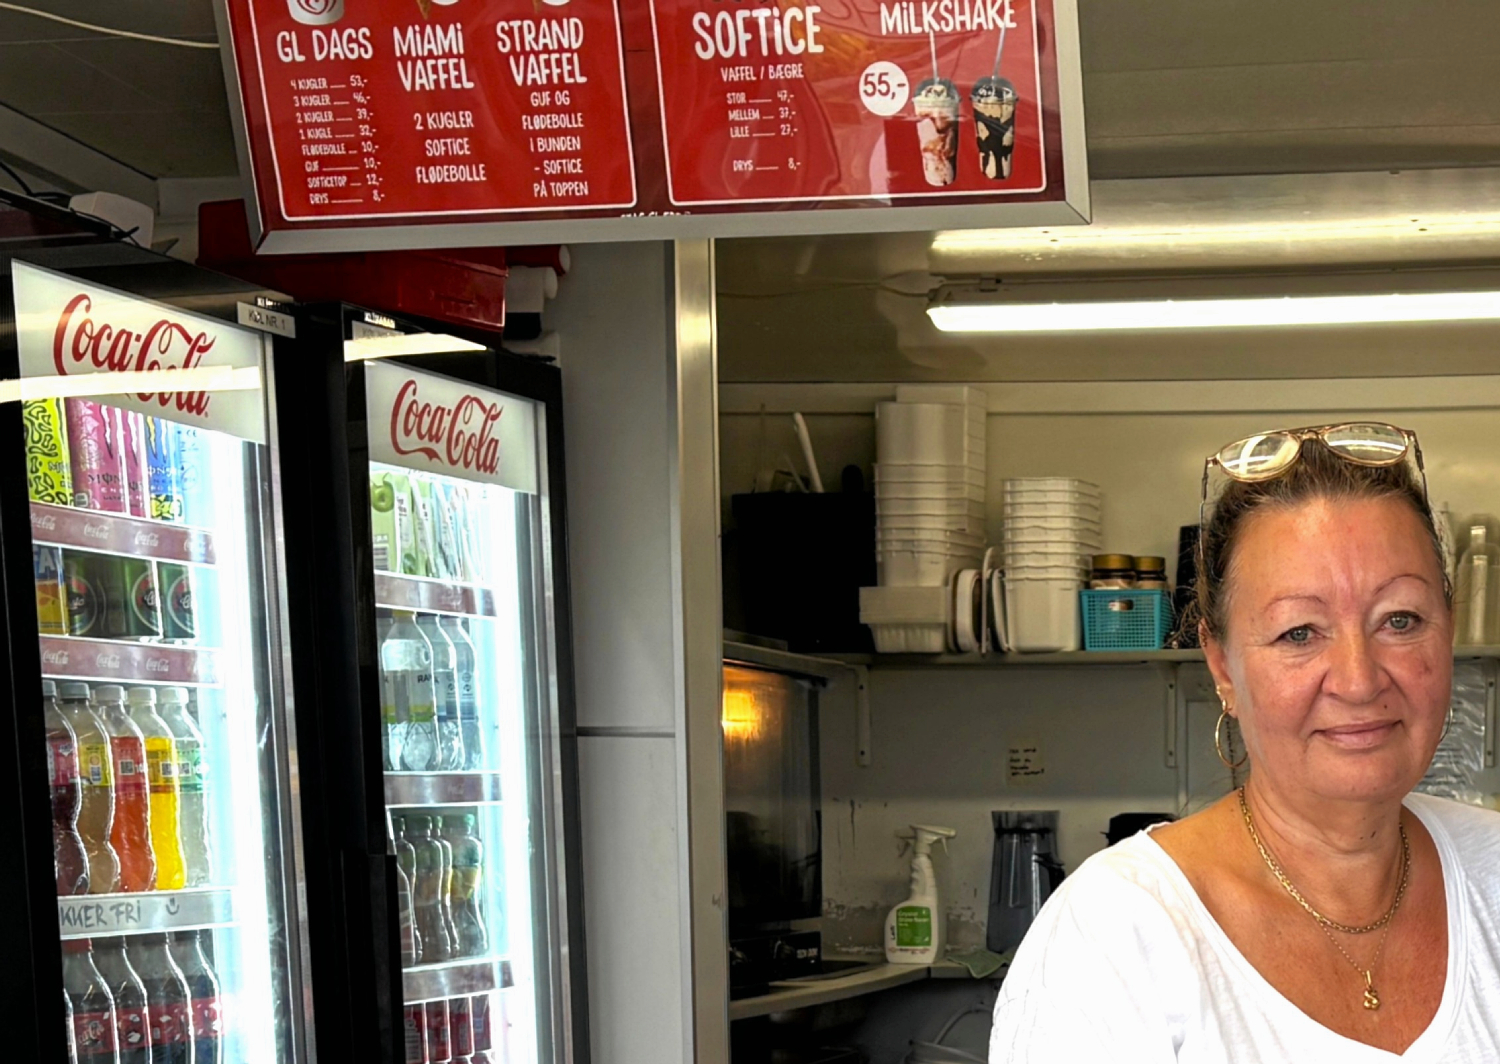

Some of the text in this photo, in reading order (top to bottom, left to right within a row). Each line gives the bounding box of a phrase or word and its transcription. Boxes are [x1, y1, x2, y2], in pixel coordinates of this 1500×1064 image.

[276, 27, 373, 63] GL DAGS
[497, 18, 584, 54] STRAND
[397, 58, 474, 92] VAFFEL
[509, 52, 587, 86] VAFFEL
[721, 66, 757, 82] VAFFEL
[769, 63, 804, 80] BÆGRE
[298, 78, 328, 90] KUGLER
[300, 94, 332, 106] KUGLER
[530, 91, 570, 106] GUF OG
[727, 92, 746, 104] STOR
[303, 111, 335, 123] KUGLER
[414, 111, 474, 130] 2 KUGLER
[522, 114, 584, 130] FLØDEBOLLE
[729, 108, 760, 121] MELLEM
[537, 136, 581, 151] BUNDEN
[416, 163, 487, 184] FLØDEBOLLE
[733, 159, 753, 172] DRYS
[533, 180, 589, 198] PÅ TOPPEN
[54, 293, 216, 417] Coca-Cola
[390, 379, 503, 475] Coca-Cola
